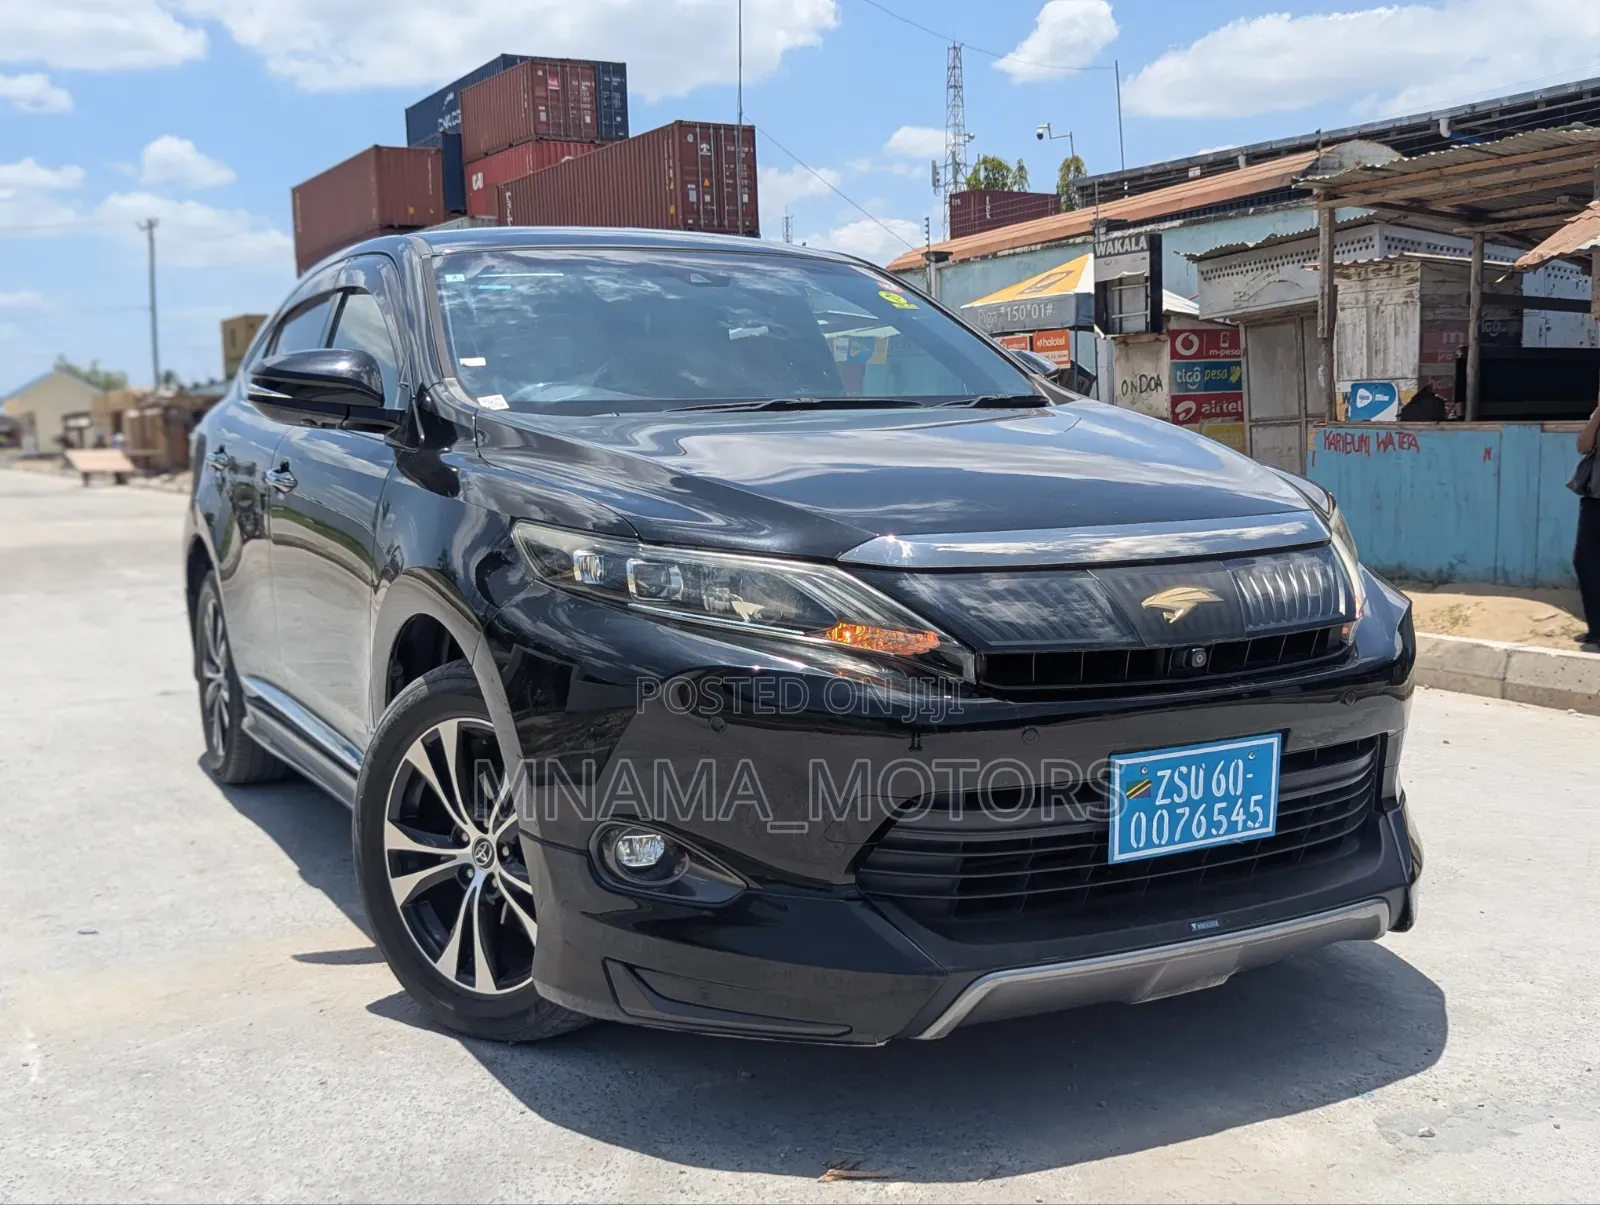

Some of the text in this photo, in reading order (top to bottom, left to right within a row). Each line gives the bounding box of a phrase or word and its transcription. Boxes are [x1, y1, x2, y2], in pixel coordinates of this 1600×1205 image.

[1094, 235, 1148, 257] WAKALA
[978, 308, 997, 329] Piga
[1209, 348, 1241, 358] m-pesa
[1121, 374, 1163, 396] ONDOA
[1204, 368, 1228, 383] pesa
[1201, 400, 1243, 414] airtel
[1155, 759, 1254, 806] ZSU 60-
[1130, 794, 1264, 849] 0076545
